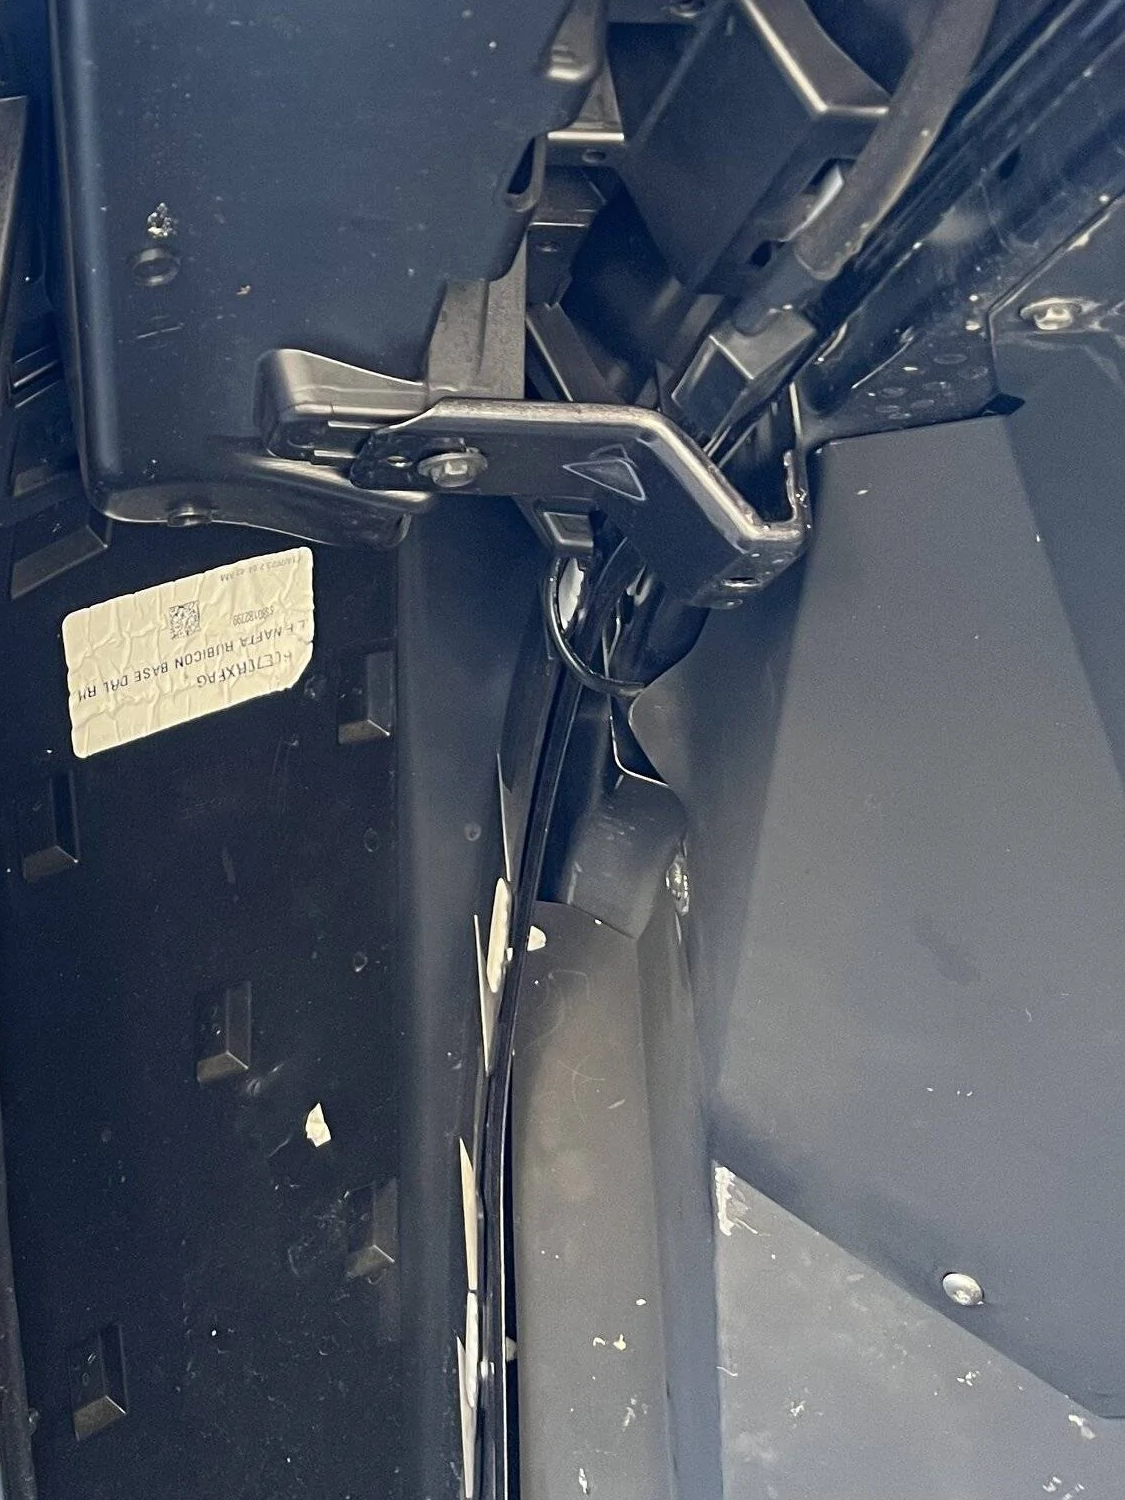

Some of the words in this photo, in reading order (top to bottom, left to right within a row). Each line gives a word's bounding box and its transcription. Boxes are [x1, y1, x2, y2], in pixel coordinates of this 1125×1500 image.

[175, 641, 234, 669] RUBICON
[134, 662, 168, 681] BASE
[104, 674, 128, 691] DRL
[78, 686, 96, 702] RH
